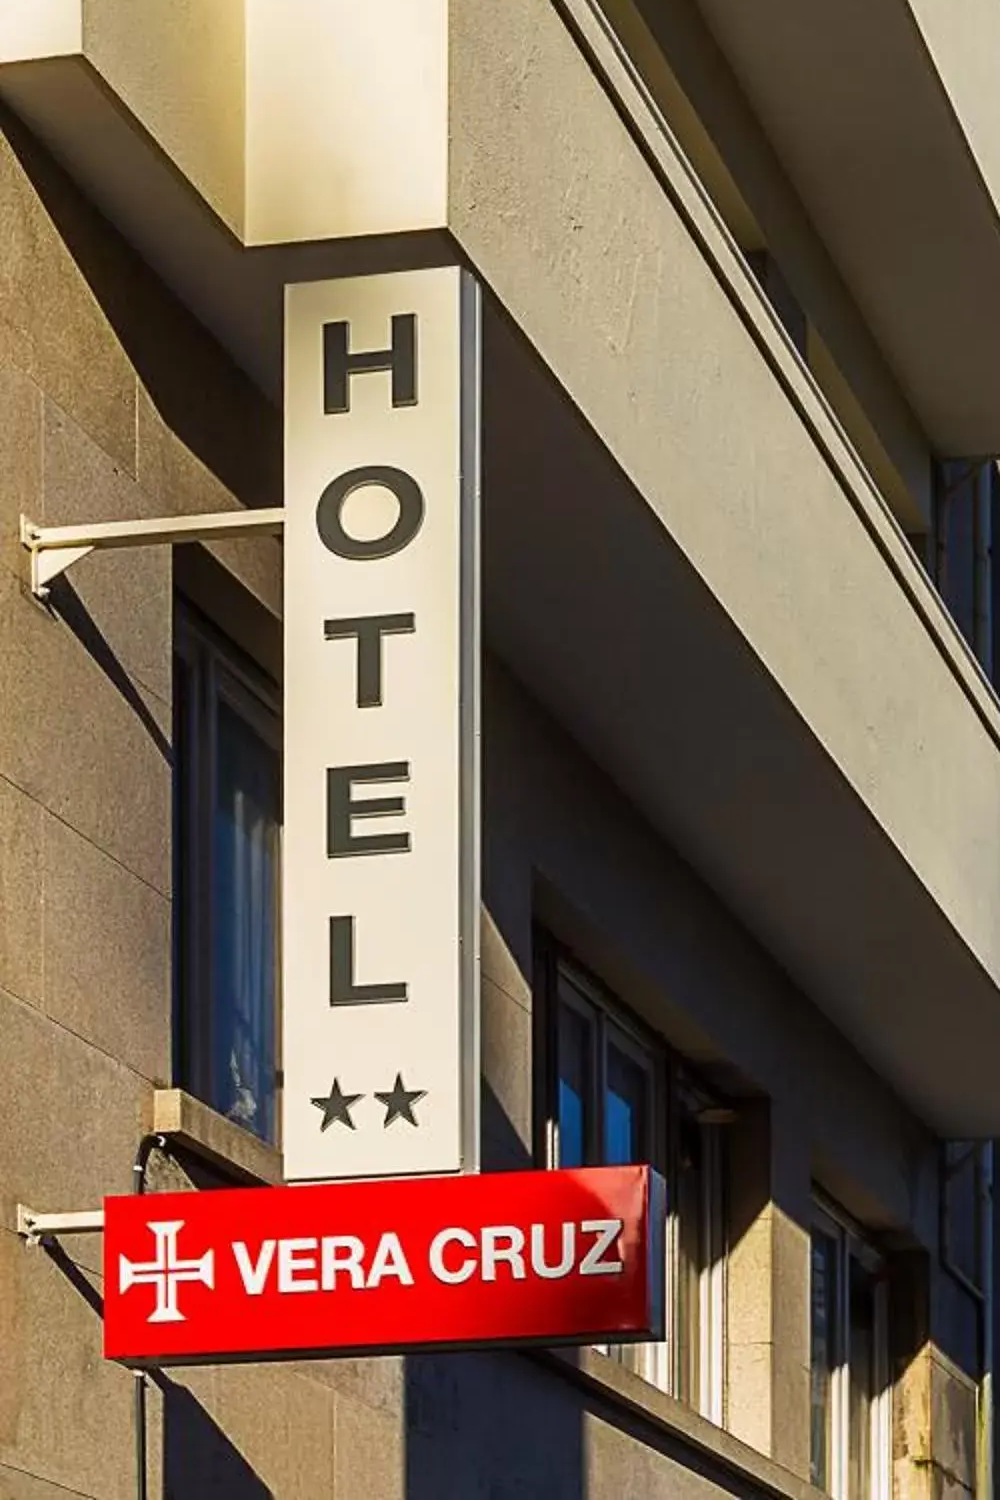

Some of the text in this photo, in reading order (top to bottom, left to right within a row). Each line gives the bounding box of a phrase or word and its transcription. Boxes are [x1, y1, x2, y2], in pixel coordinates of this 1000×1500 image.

[316, 313, 425, 1006] HOTEL
[232, 1220, 624, 1295] VERA CRUZ
